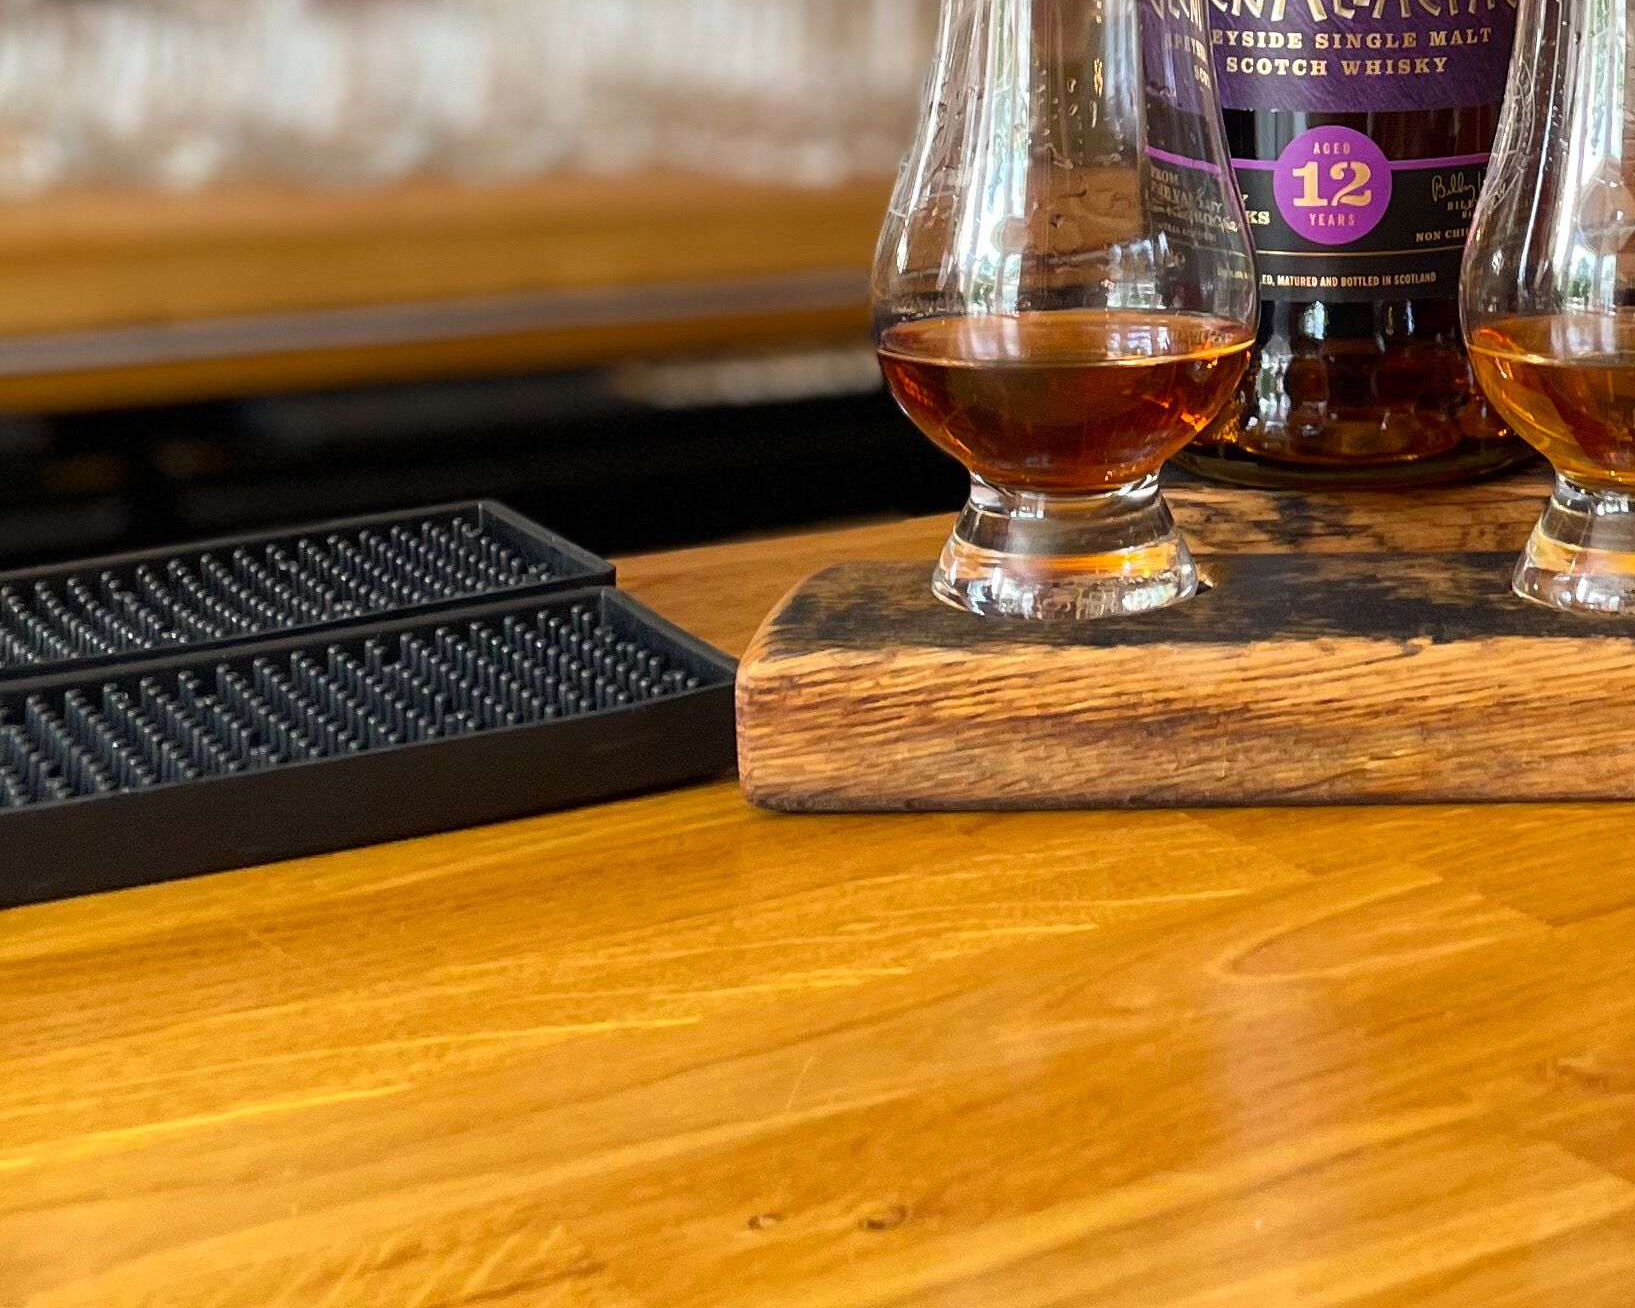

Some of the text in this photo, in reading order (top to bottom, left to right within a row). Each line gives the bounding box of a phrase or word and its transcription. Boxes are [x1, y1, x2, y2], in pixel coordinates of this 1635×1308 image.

[1315, 32, 1417, 49] SINGLE
[1428, 27, 1492, 46] MALT
[1226, 56, 1327, 76] SCOTCH
[1341, 56, 1447, 76] WHISKY
[1313, 142, 1351, 155] AGED
[1292, 161, 1371, 207] 12
[1309, 213, 1355, 227] YEARS
[1416, 232, 1441, 242] NON
[1277, 275, 1317, 287] MATURED
[1320, 275, 1338, 287] AND
[1341, 275, 1379, 286] BOTTLED
[1382, 275, 1391, 285] IN
[1394, 272, 1437, 285] SCOTLAND
